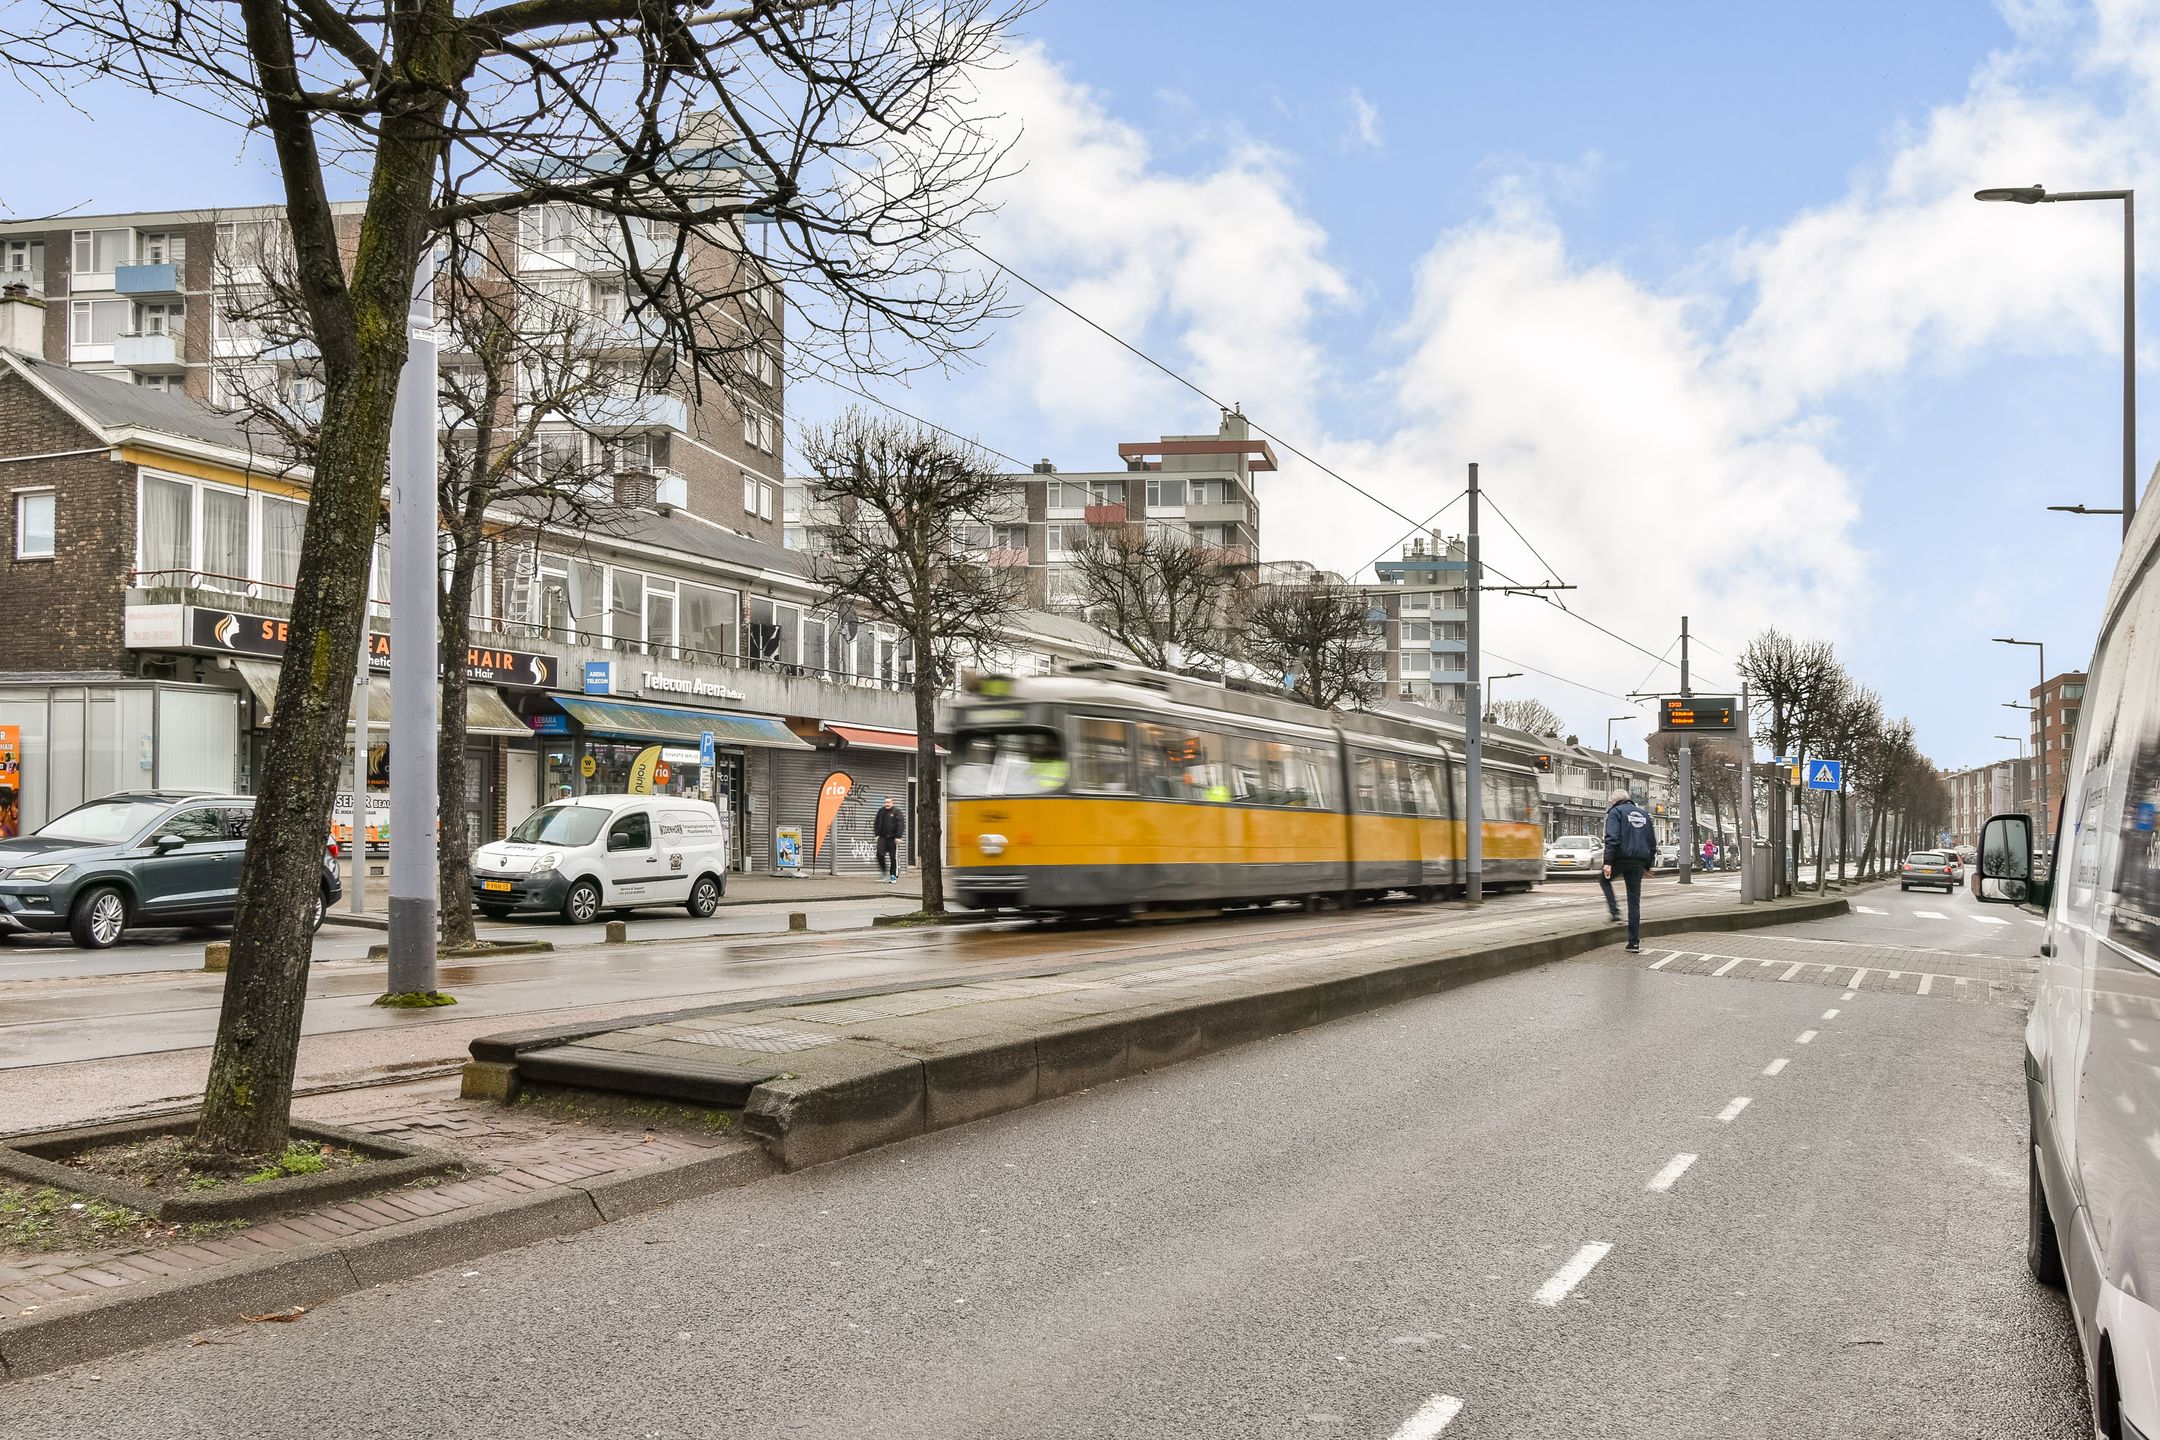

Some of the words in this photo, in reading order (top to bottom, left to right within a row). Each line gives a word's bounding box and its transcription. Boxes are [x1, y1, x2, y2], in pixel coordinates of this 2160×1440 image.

[261, 620, 288, 642] SE
[368, 635, 390, 655] EA
[467, 649, 514, 671] HAIR
[368, 655, 390, 667] hetic
[474, 668, 494, 679] Hair
[642, 671, 692, 694] Telecom
[692, 678, 726, 697] Arena
[534, 716, 557, 724] LEBARA
[703, 735, 712, 752] P
[655, 764, 669, 778] ria
[826, 782, 846, 796] ria
[335, 794, 371, 808] SEHR
[373, 799, 391, 809] BEAU
